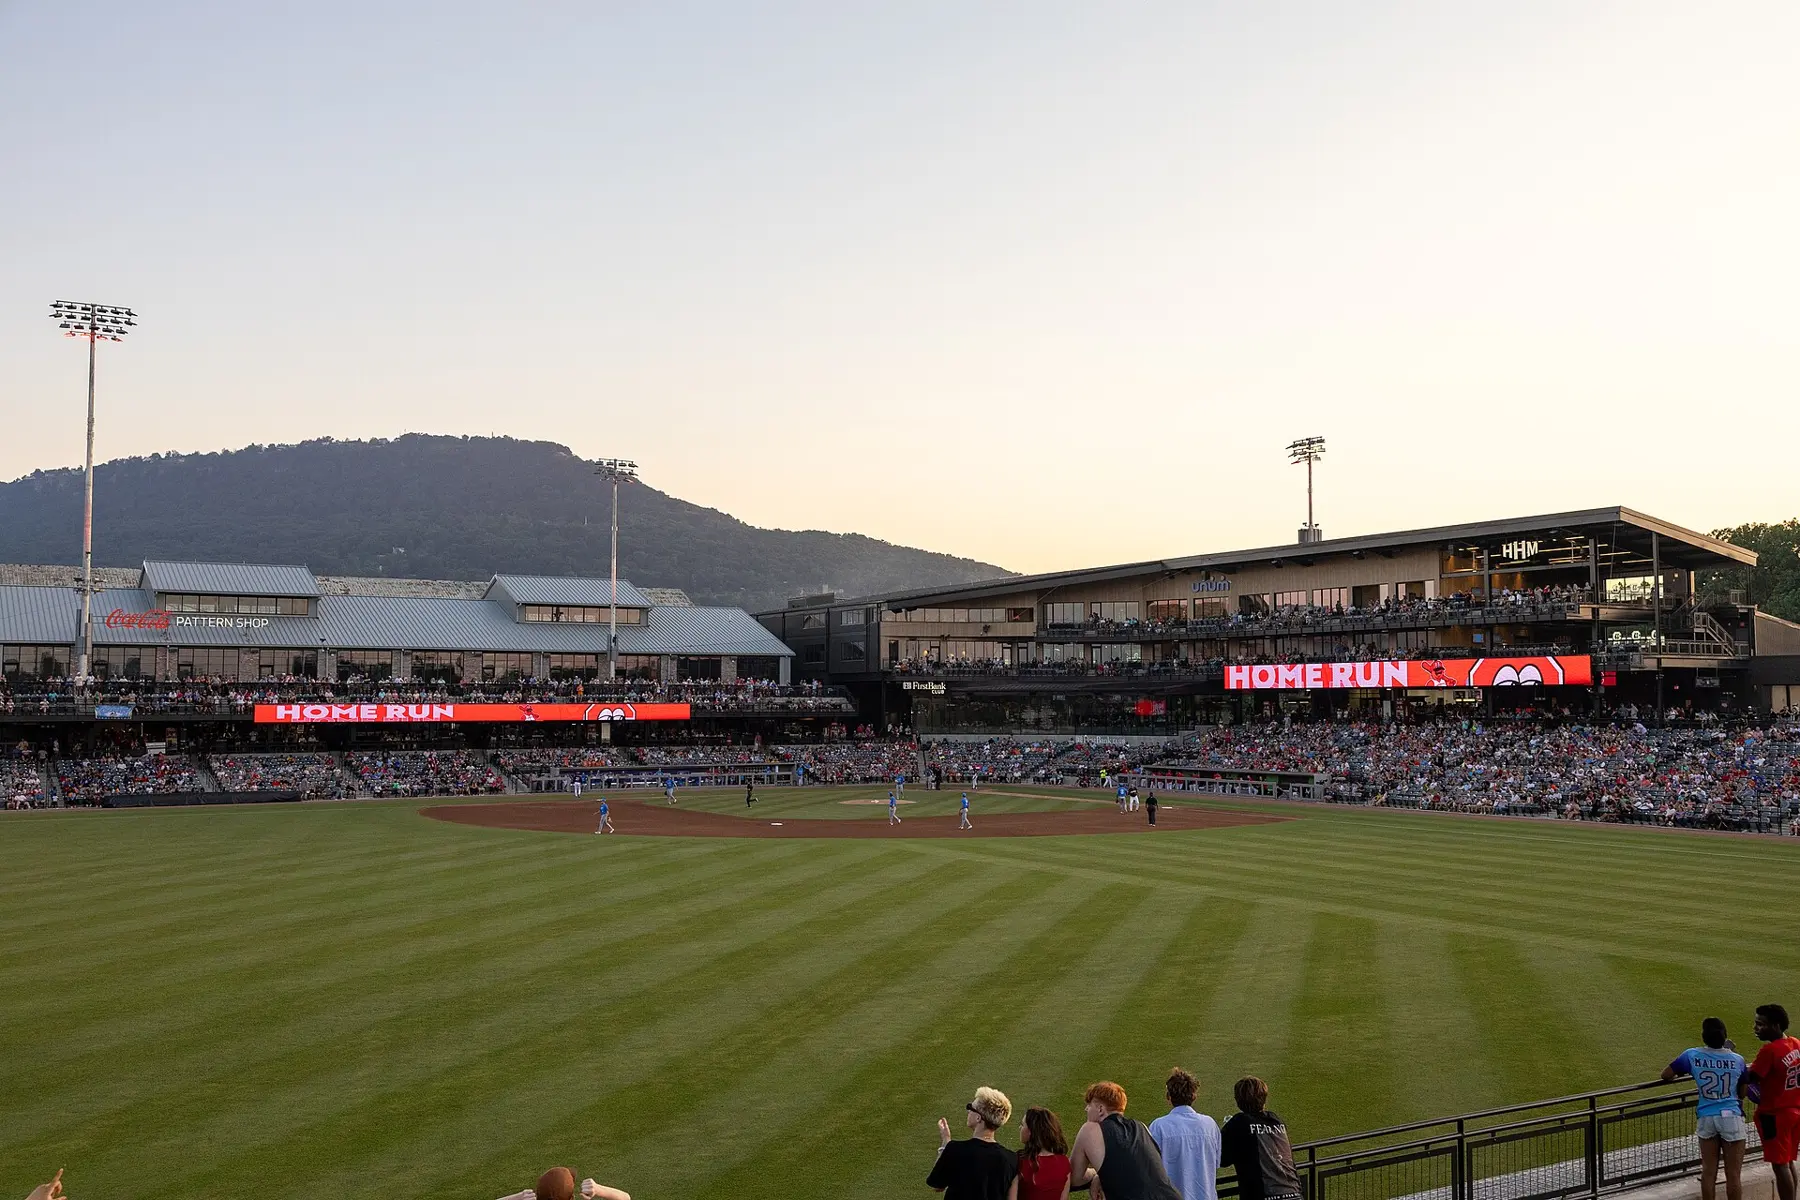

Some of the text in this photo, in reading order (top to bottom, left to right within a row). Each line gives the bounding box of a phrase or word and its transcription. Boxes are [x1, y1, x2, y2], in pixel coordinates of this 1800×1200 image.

[1502, 541, 1538, 560] HHM
[105, 608, 269, 629] Coca-Cola PATTERN SHOP
[1229, 661, 1408, 689] HOME RUN
[912, 681, 946, 690] FirstBank
[276, 704, 454, 719] HOME RUN
[1694, 1057, 1737, 1070] MALONE
[1699, 1070, 1733, 1100] 21
